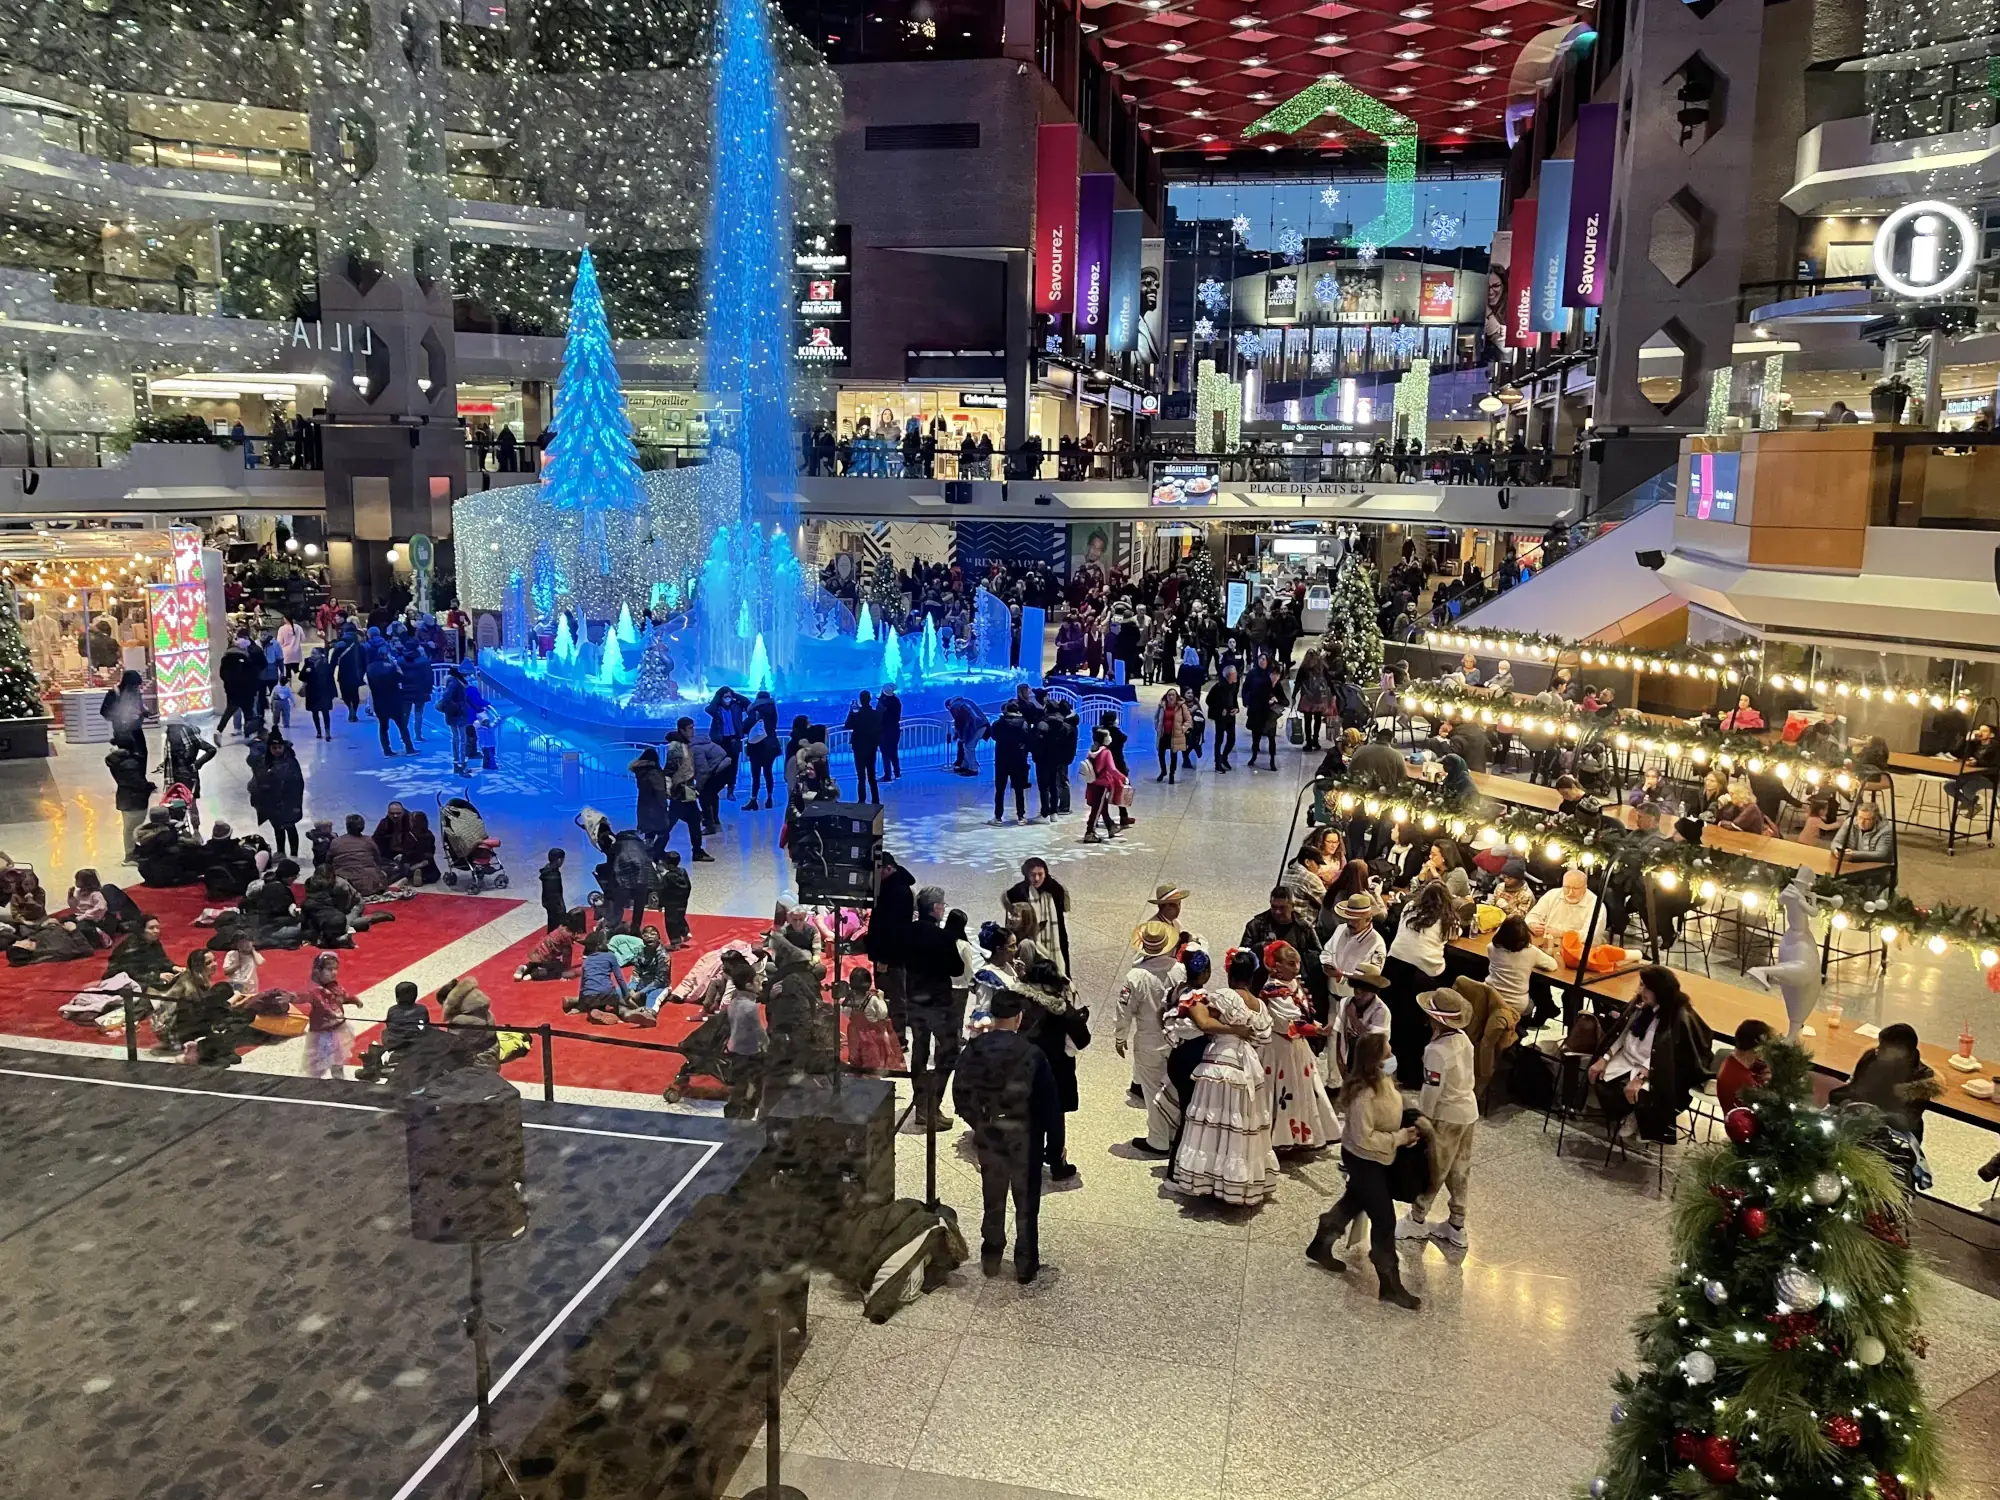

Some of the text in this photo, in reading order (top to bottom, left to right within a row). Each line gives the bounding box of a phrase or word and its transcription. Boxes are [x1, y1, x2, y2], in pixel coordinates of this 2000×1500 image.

[1049, 225, 1063, 301] Savourez.
[1577, 212, 1600, 294] Savourez.
[801, 305, 841, 313] EN ROUTE
[1087, 261, 1101, 325] Célébrez.
[1516, 286, 1531, 339] Profitez.
[1542, 254, 1559, 321] Célébrez.
[798, 346, 844, 356] KINATEX
[652, 396, 689, 408] Joaillier
[1250, 484, 1346, 494] PLACE DES ARTS
